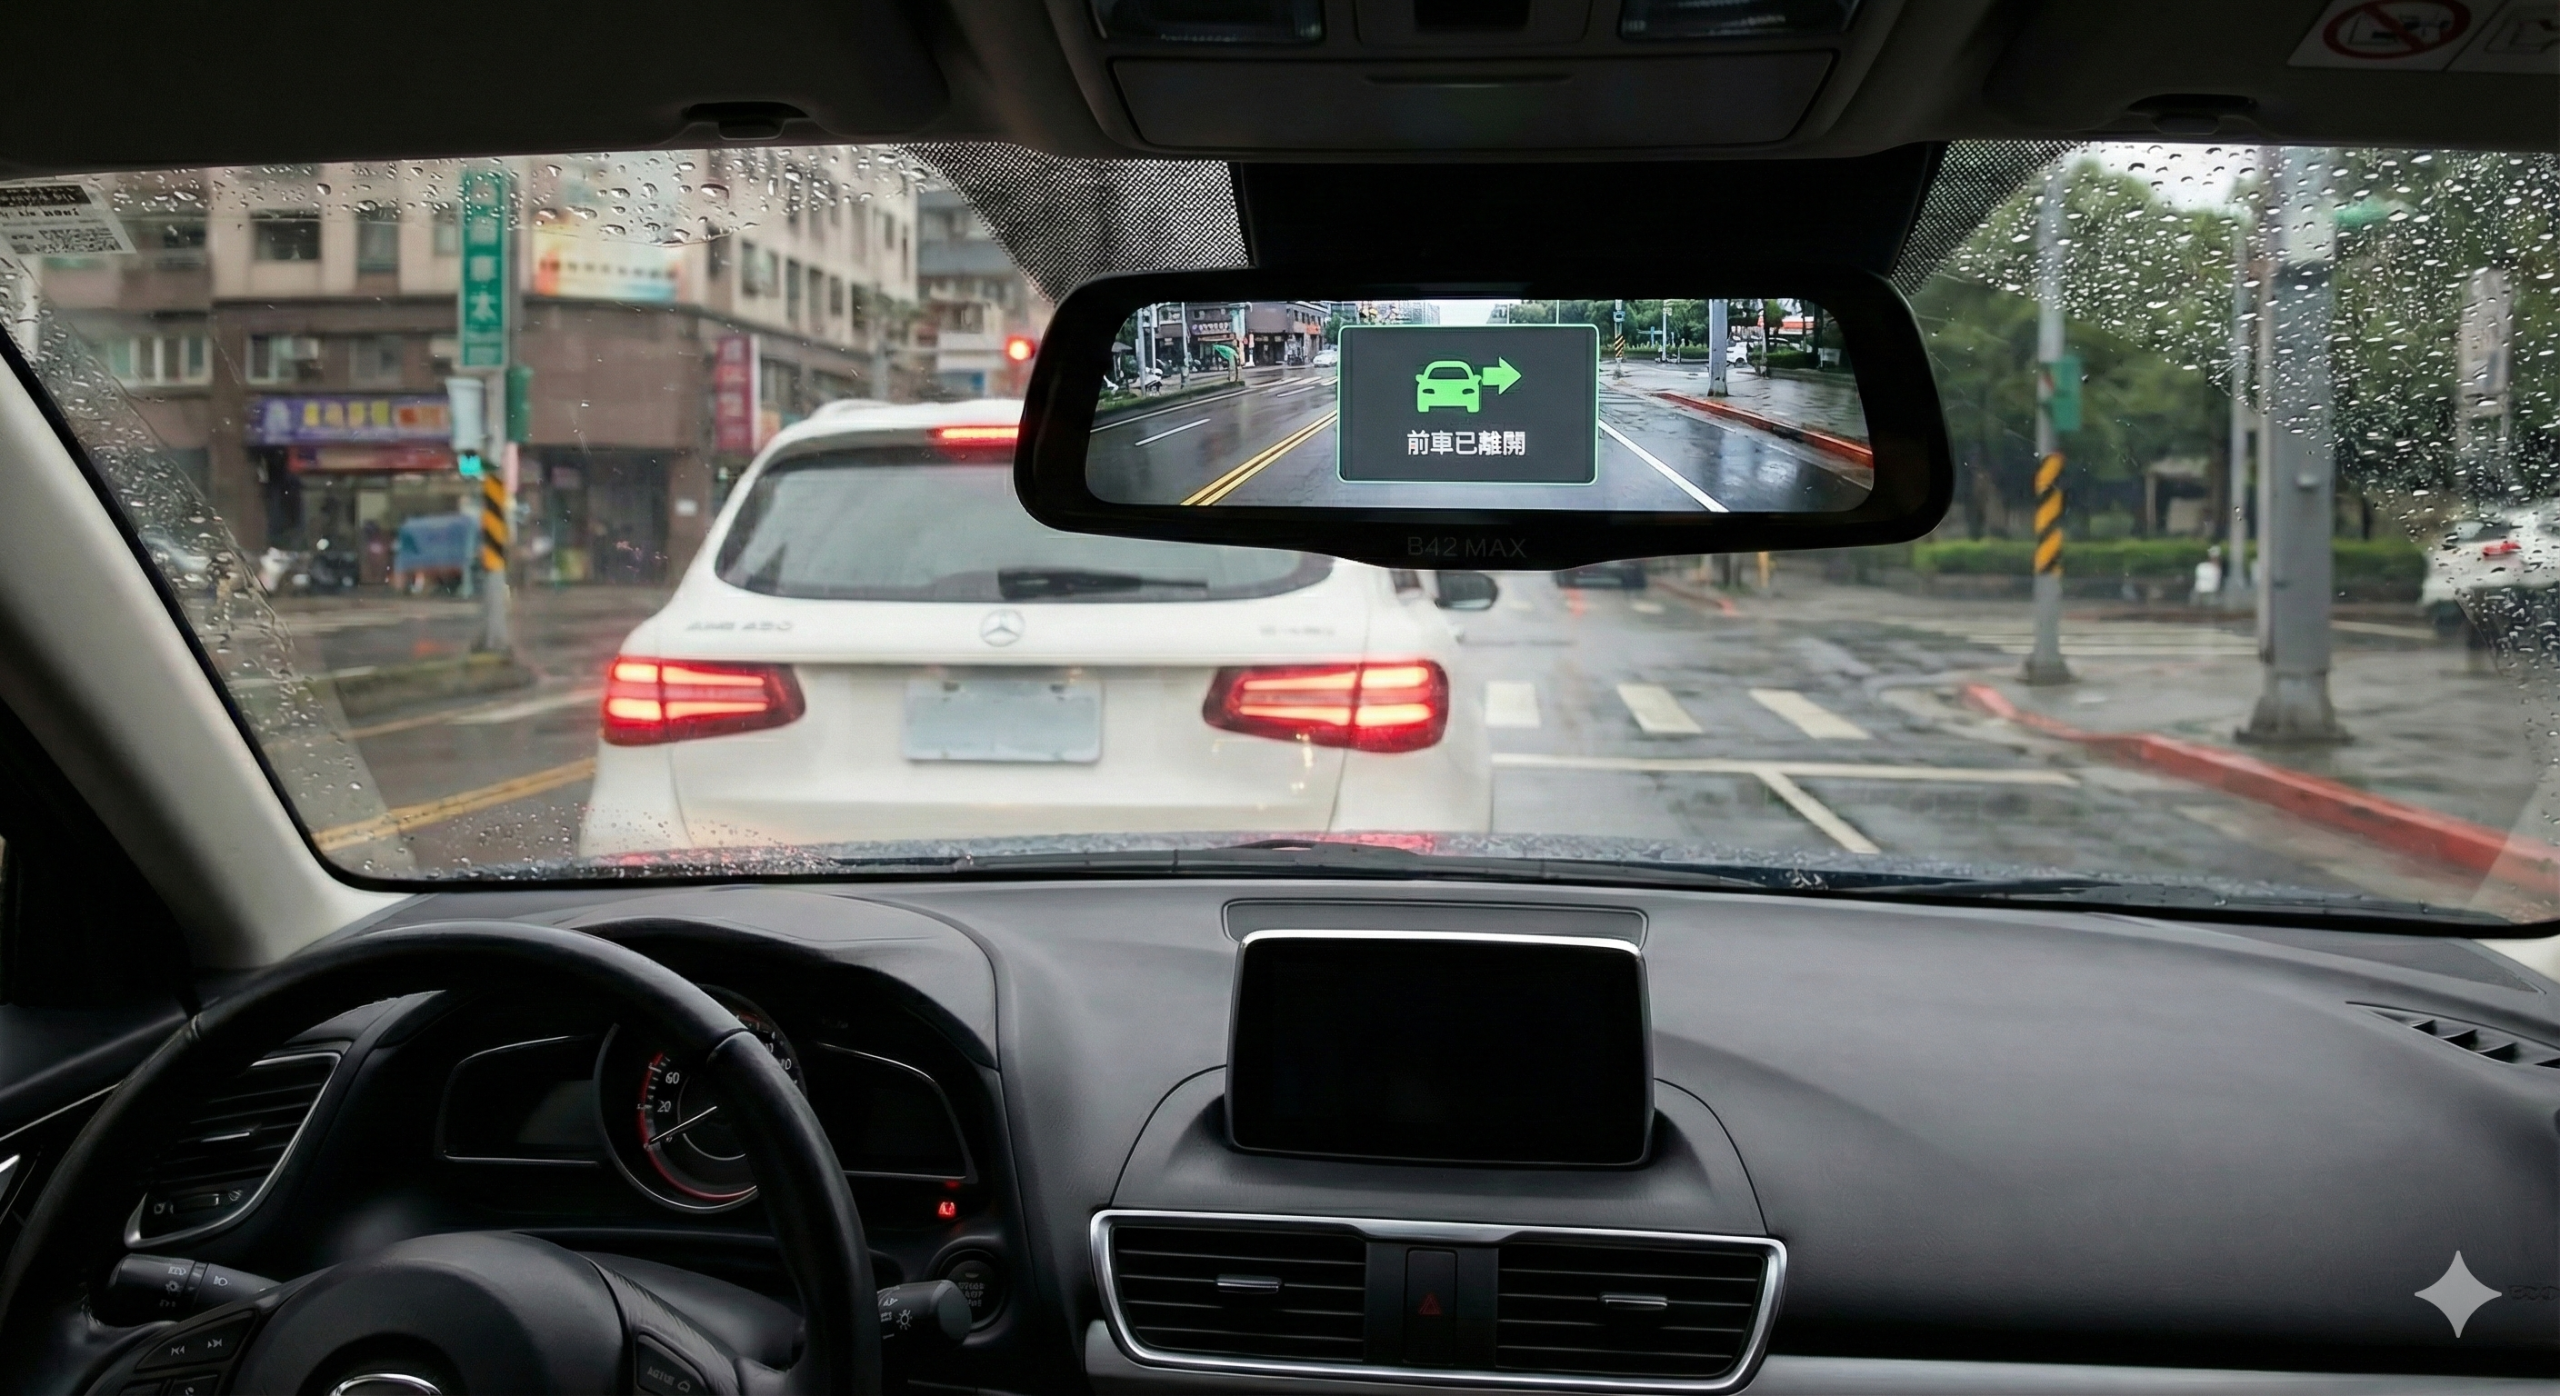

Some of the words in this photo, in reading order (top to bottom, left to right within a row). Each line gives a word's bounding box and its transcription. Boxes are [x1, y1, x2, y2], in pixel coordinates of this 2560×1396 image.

[1406, 429, 1526, 456] 前車已離開
[1407, 536, 1458, 557] B42
[1465, 537, 1527, 558] MAX
